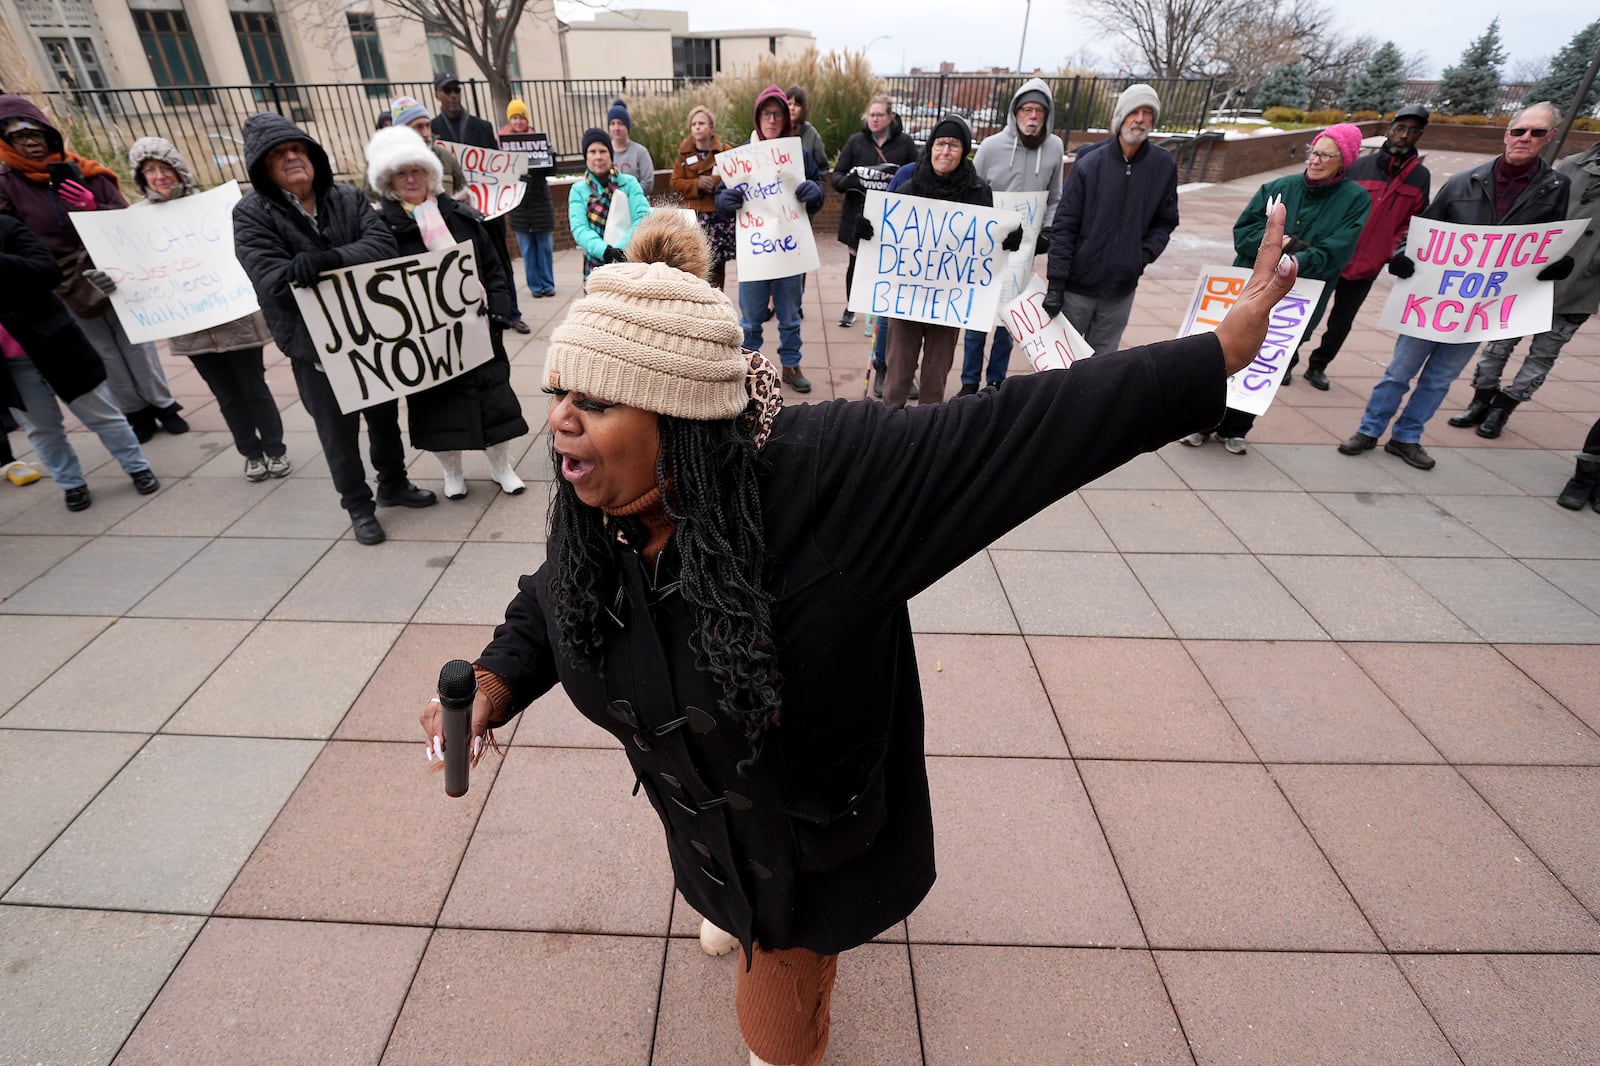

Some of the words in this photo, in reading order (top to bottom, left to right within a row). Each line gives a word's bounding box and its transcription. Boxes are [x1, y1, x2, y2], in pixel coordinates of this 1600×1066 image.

[436, 141, 519, 174] NOUGH
[502, 140, 548, 151] BELIEVE
[463, 169, 499, 186] IS
[723, 158, 752, 178] Who
[856, 166, 895, 180] ELIEV
[733, 178, 783, 201] Protect
[739, 211, 764, 229] Who
[879, 198, 998, 257] KANSAS
[878, 243, 993, 287] DESERVES
[1416, 228, 1564, 268] JUSTICE
[313, 250, 480, 354] JUSTICE
[1438, 269, 1508, 299] FOR
[872, 280, 974, 325] BETTER!
[1400, 293, 1518, 333] KCK!
[347, 321, 464, 400] NOW!
[1243, 295, 1310, 392] KANSAS
